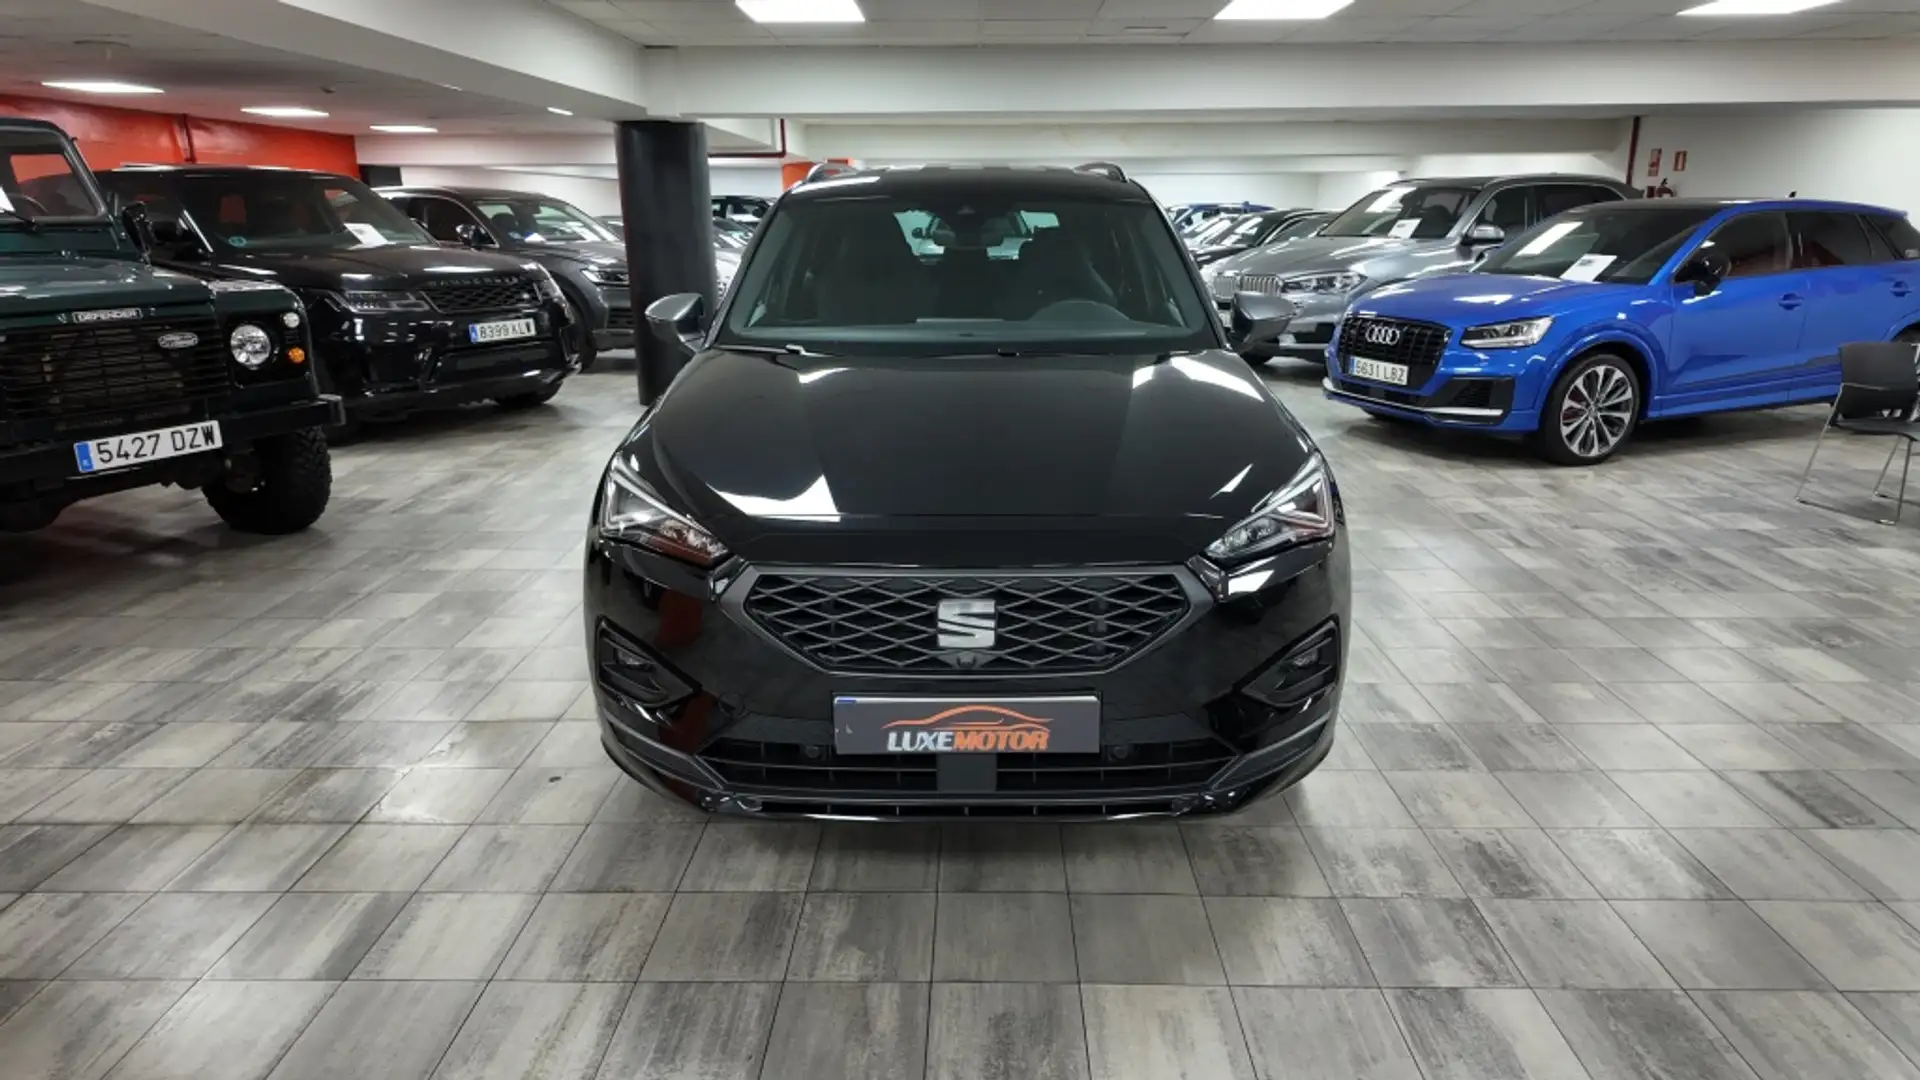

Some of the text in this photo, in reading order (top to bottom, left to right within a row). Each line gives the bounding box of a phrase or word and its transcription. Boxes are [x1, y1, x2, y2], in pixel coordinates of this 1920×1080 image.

[480, 323, 509, 339] 8399
[96, 425, 216, 464] 5427 DZW
